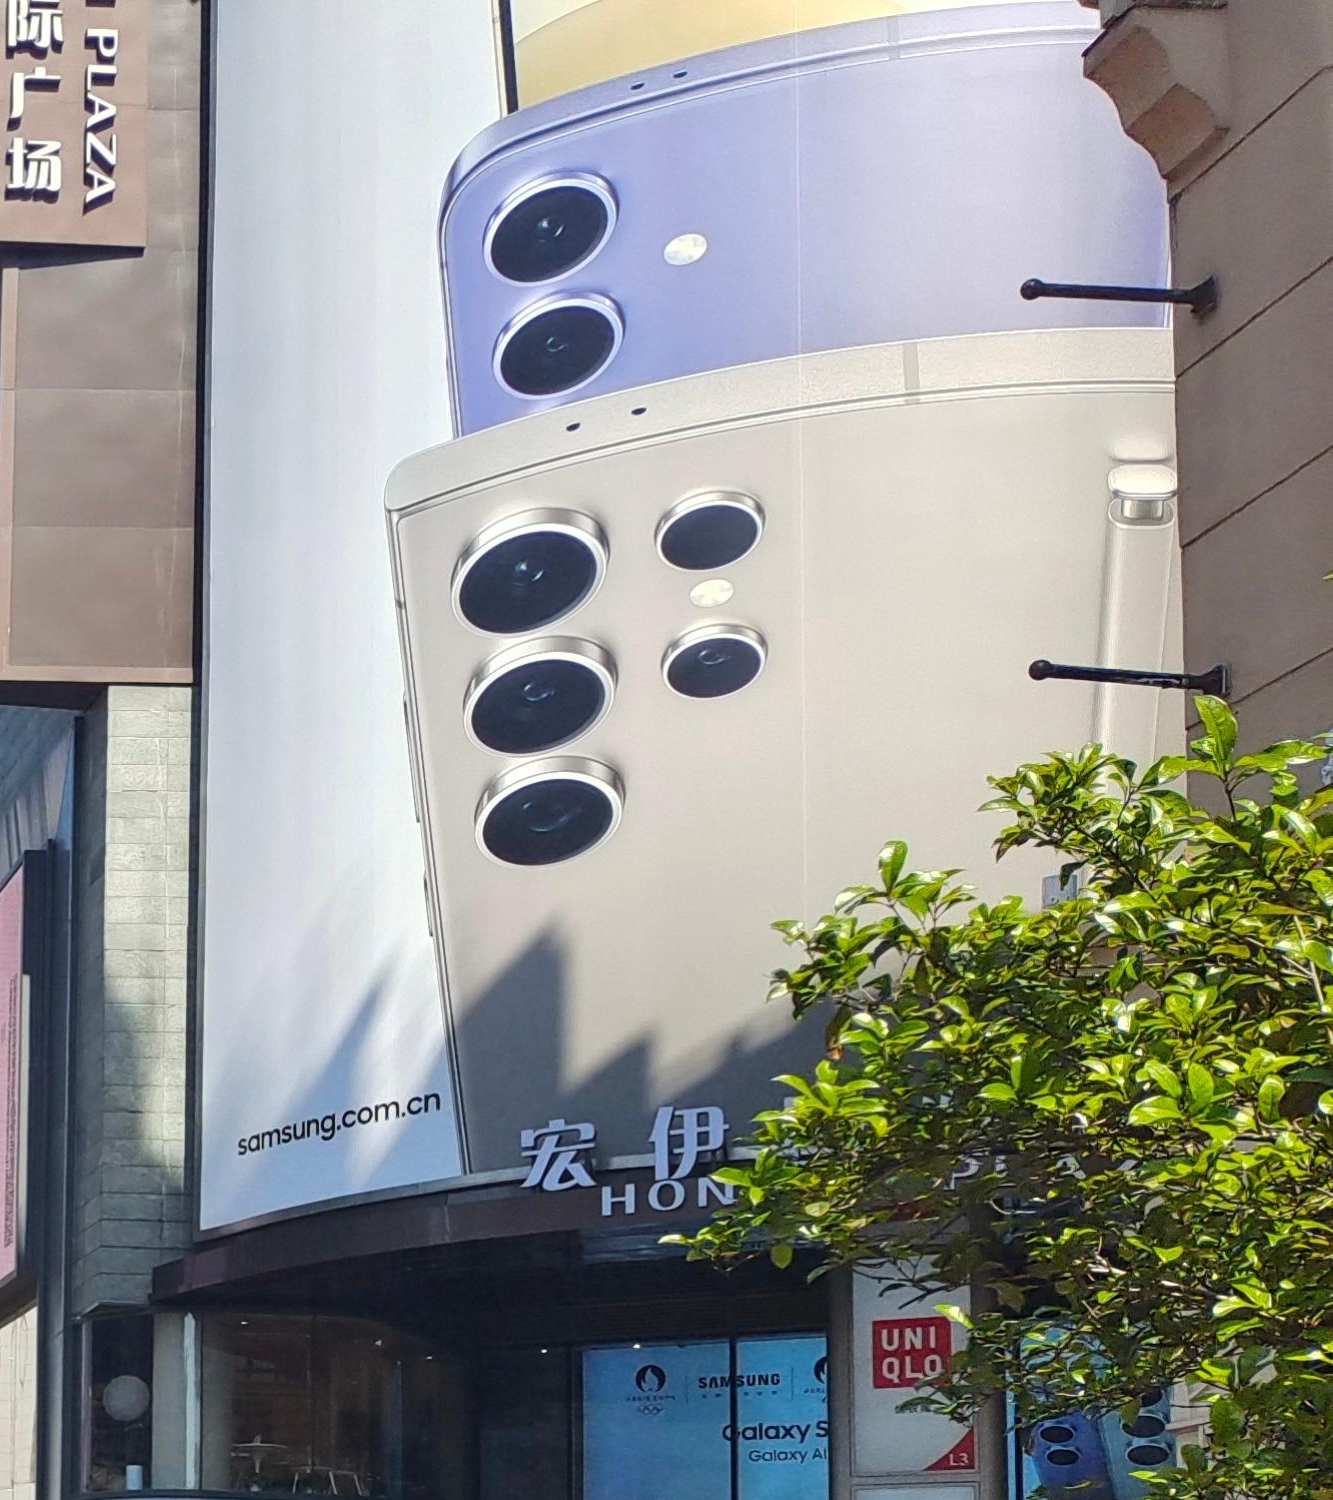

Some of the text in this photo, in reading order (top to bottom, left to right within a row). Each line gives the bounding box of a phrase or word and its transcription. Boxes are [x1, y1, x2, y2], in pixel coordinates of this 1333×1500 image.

[85, 28, 119, 204] PLAZA
[237, 1090, 442, 1156] samsung.com.cn
[881, 1326, 936, 1351] UNI
[882, 1354, 944, 1384] QLO
[698, 1373, 781, 1389] SAMSUNG
[722, 1422, 811, 1443] Galaxy
[749, 1450, 808, 1463] Galaxy
[949, 1453, 969, 1466] L3
